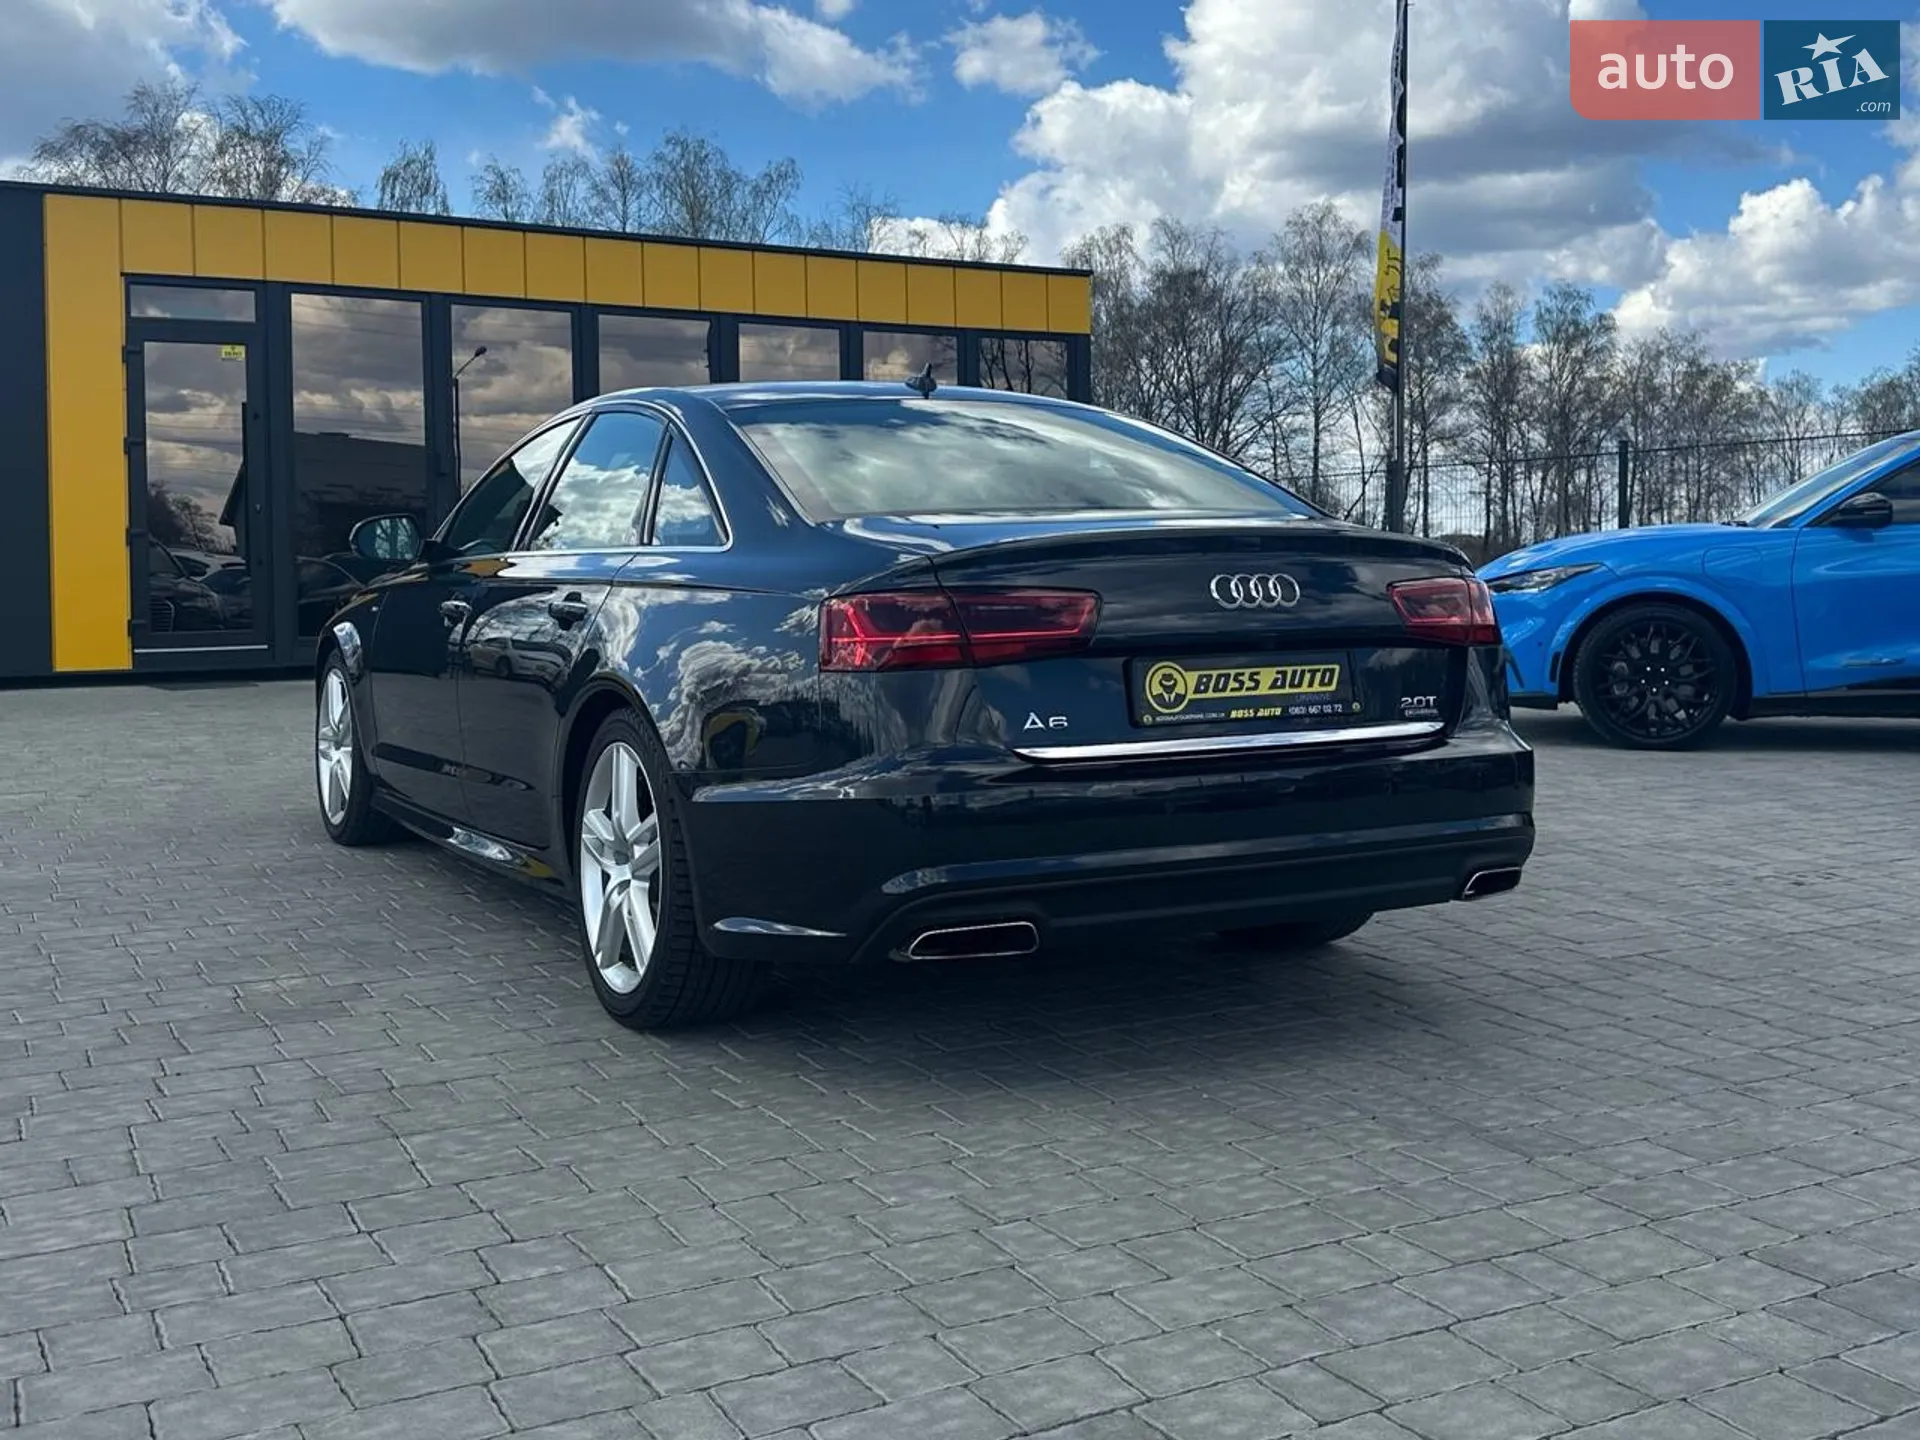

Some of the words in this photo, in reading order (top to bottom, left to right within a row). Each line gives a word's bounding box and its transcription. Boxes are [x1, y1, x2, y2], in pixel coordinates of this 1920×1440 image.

[1193, 672, 1261, 694] BOSS
[1268, 667, 1337, 690] AUTO
[1022, 711, 1068, 732] A6
[1229, 708, 1254, 718] BOSS
[1257, 706, 1282, 716] AUTO
